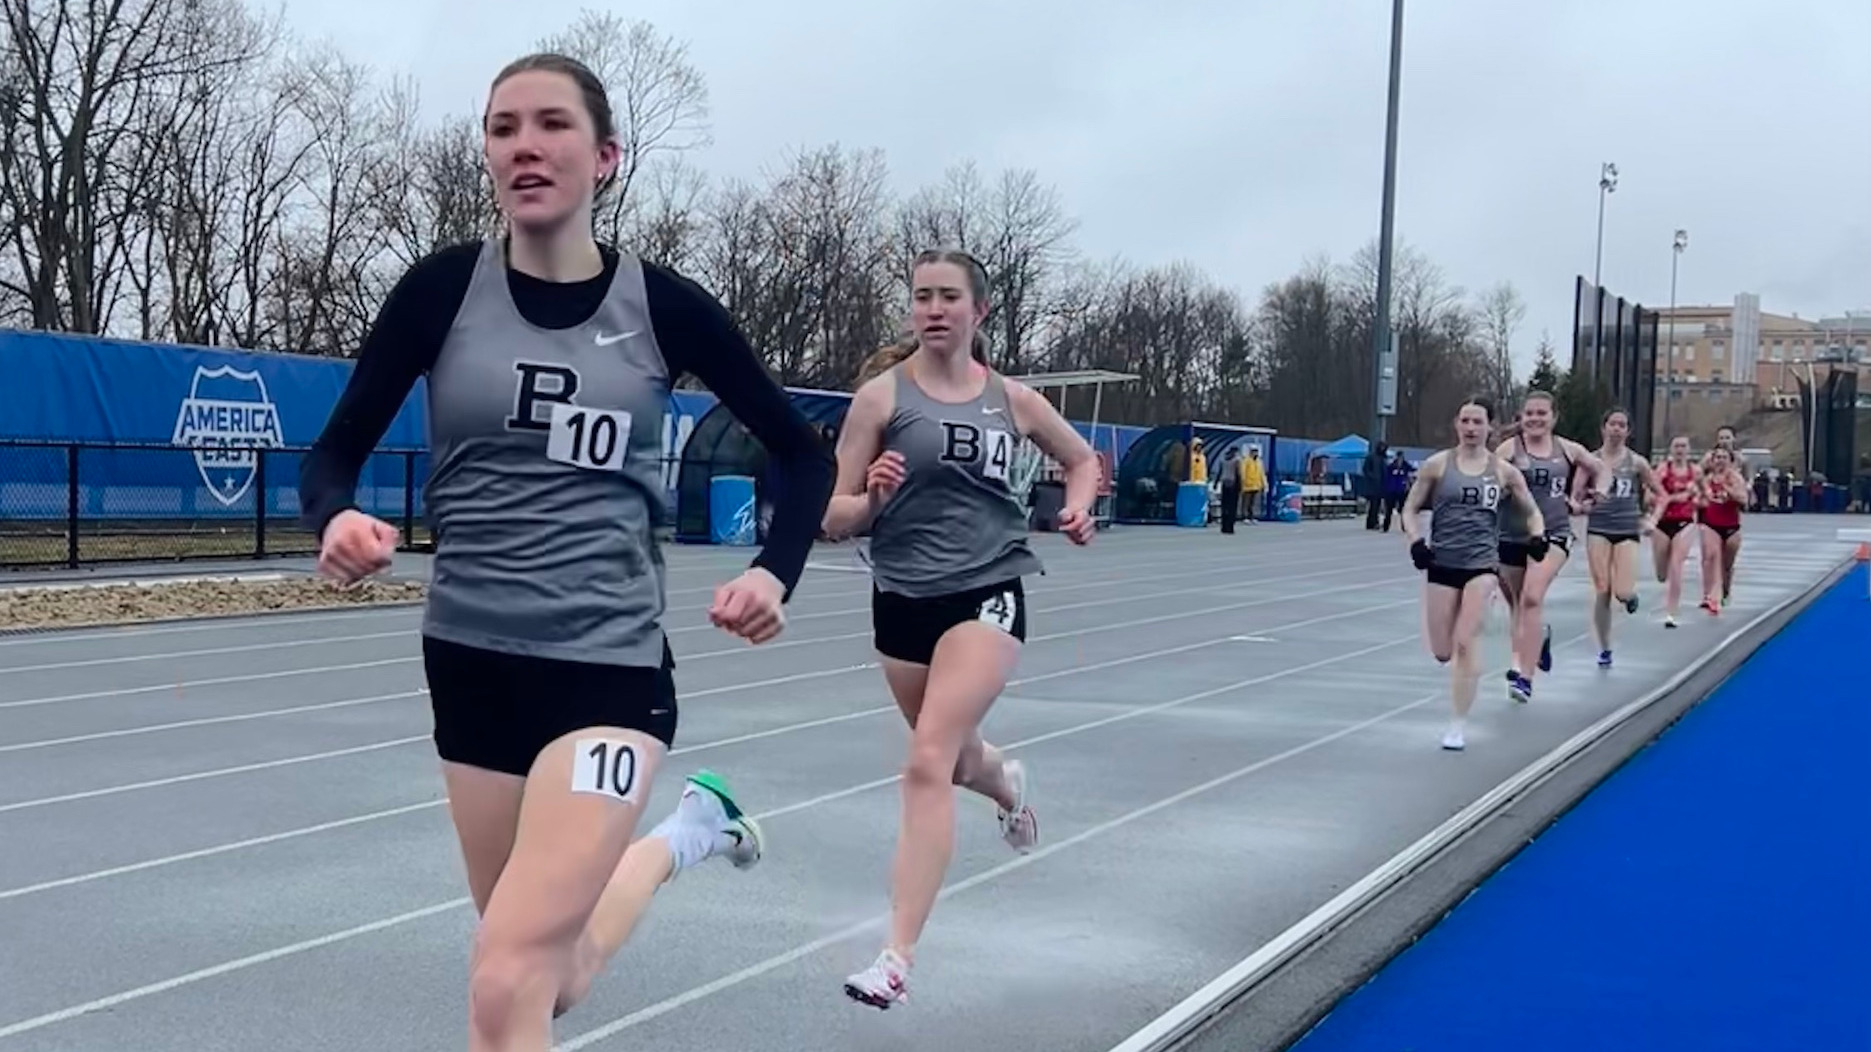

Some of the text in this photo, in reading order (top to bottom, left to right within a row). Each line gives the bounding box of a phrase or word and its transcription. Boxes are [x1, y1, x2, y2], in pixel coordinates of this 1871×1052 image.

[505, 361, 580, 434] B
[181, 405, 276, 433] AMERICA
[566, 411, 618, 466] 10
[940, 421, 981, 463] B
[992, 434, 1006, 476] 4
[1533, 468, 1549, 486] B
[1461, 487, 1479, 504] B
[1488, 487, 1497, 507] 9
[987, 594, 1009, 624] 4
[588, 742, 636, 797] 10
